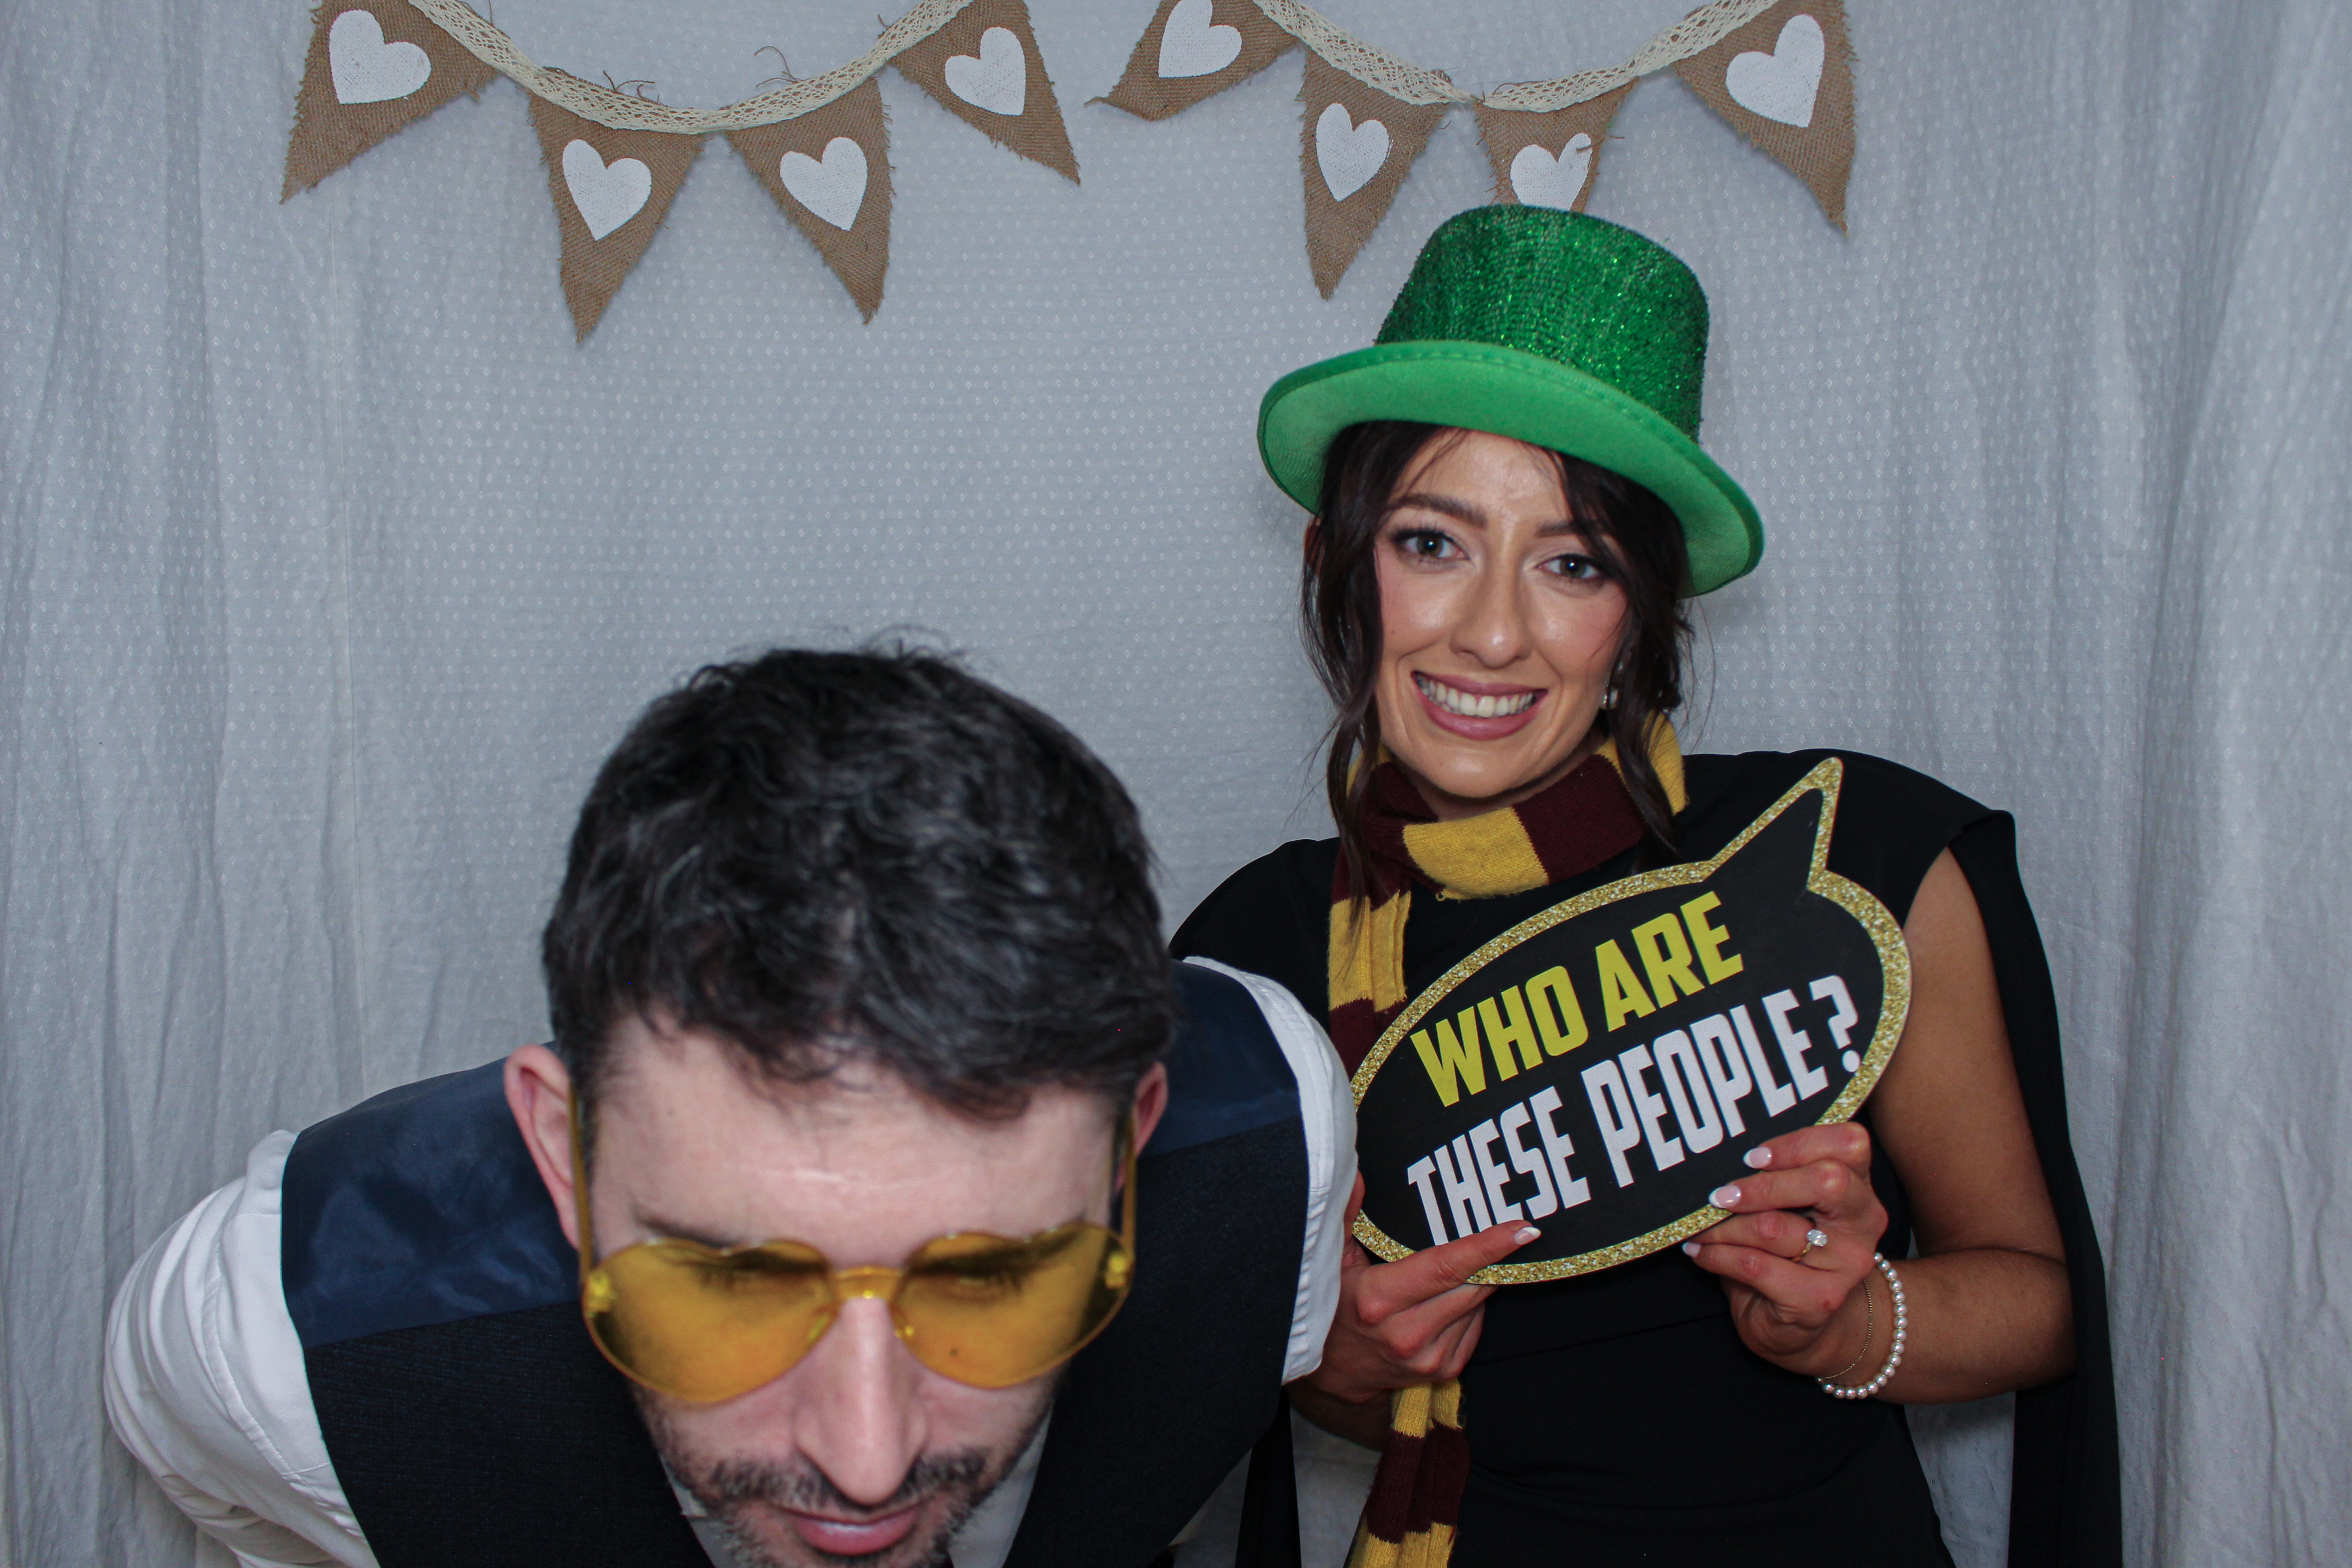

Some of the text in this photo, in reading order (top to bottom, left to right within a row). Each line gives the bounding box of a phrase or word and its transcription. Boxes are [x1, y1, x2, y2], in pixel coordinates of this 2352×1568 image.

[1407, 975, 1861, 1247] THESE PEOPLE?
[1410, 891, 1744, 1107] WHO ARE
